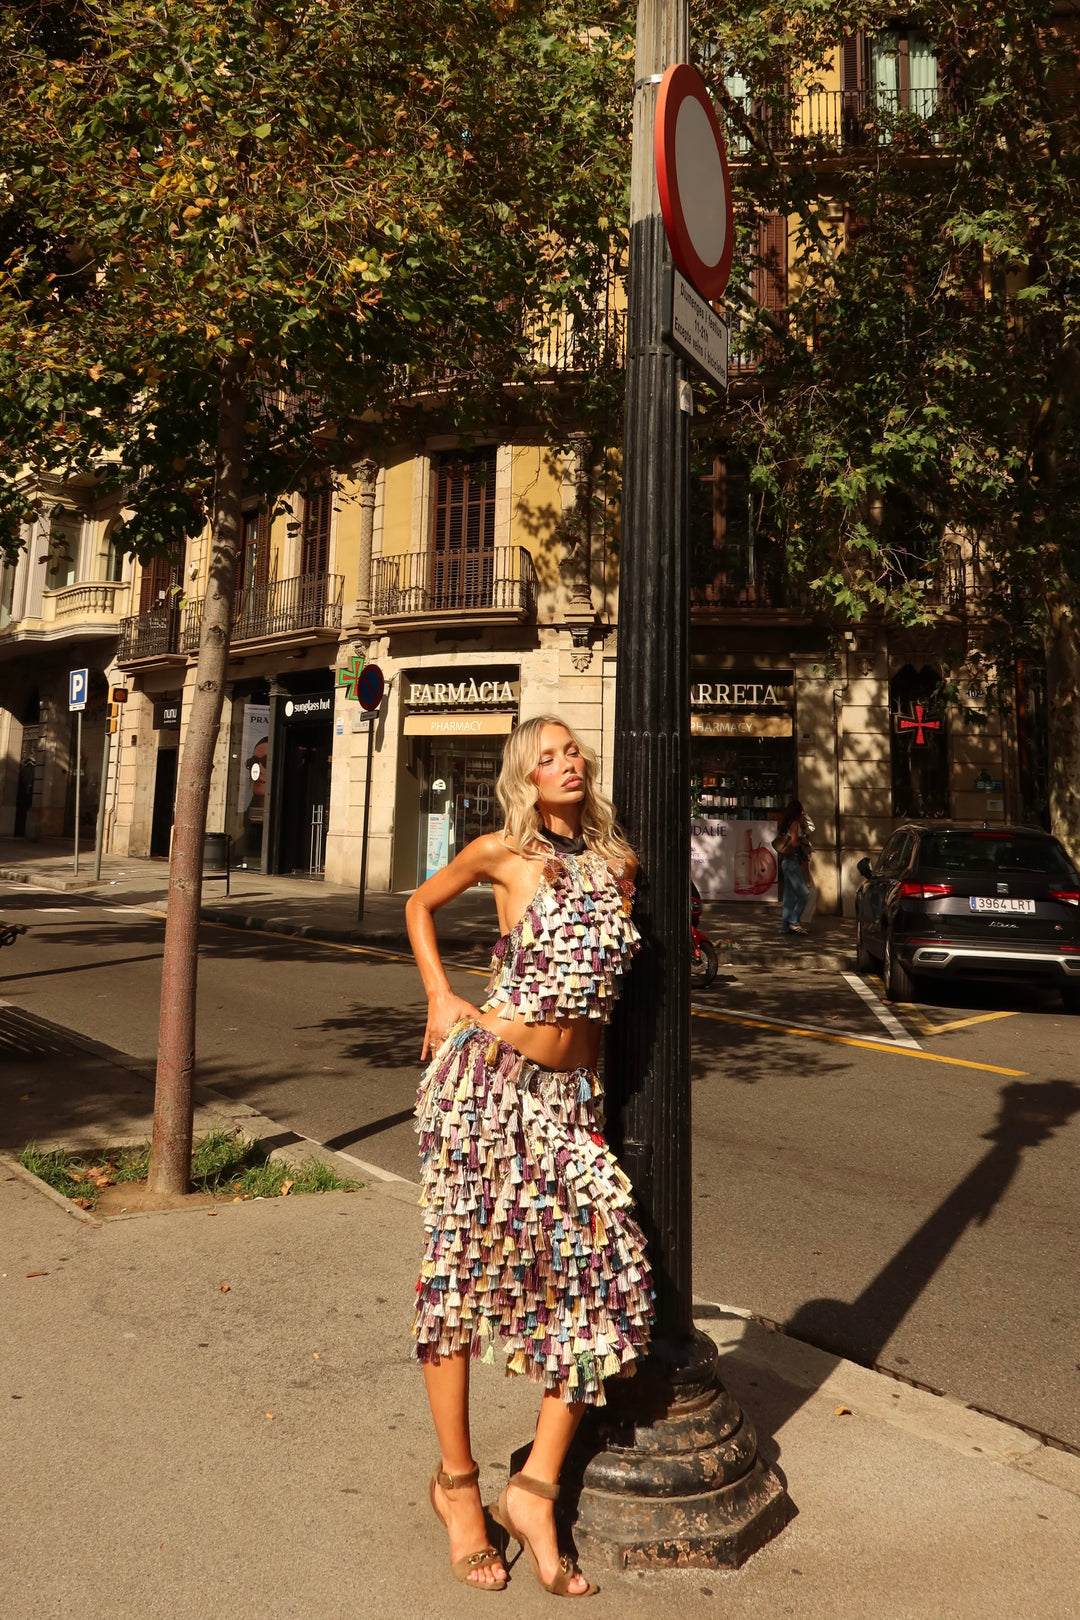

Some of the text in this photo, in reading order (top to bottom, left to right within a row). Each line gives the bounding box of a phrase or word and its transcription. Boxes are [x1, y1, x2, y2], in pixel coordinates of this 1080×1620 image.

[680, 282, 704, 319] Diumenges
[708, 314, 722, 340] festius
[694, 319, 708, 344] 11-21h
[674, 316, 691, 345] Excepte
[707, 349, 726, 380] bicicletes
[72, 674, 83, 701] P
[409, 677, 514, 704] FARMÀCIA
[294, 699, 331, 714] sunglass hut
[430, 721, 483, 732] PHARMACY
[978, 898, 1032, 912] 3964 LRT
